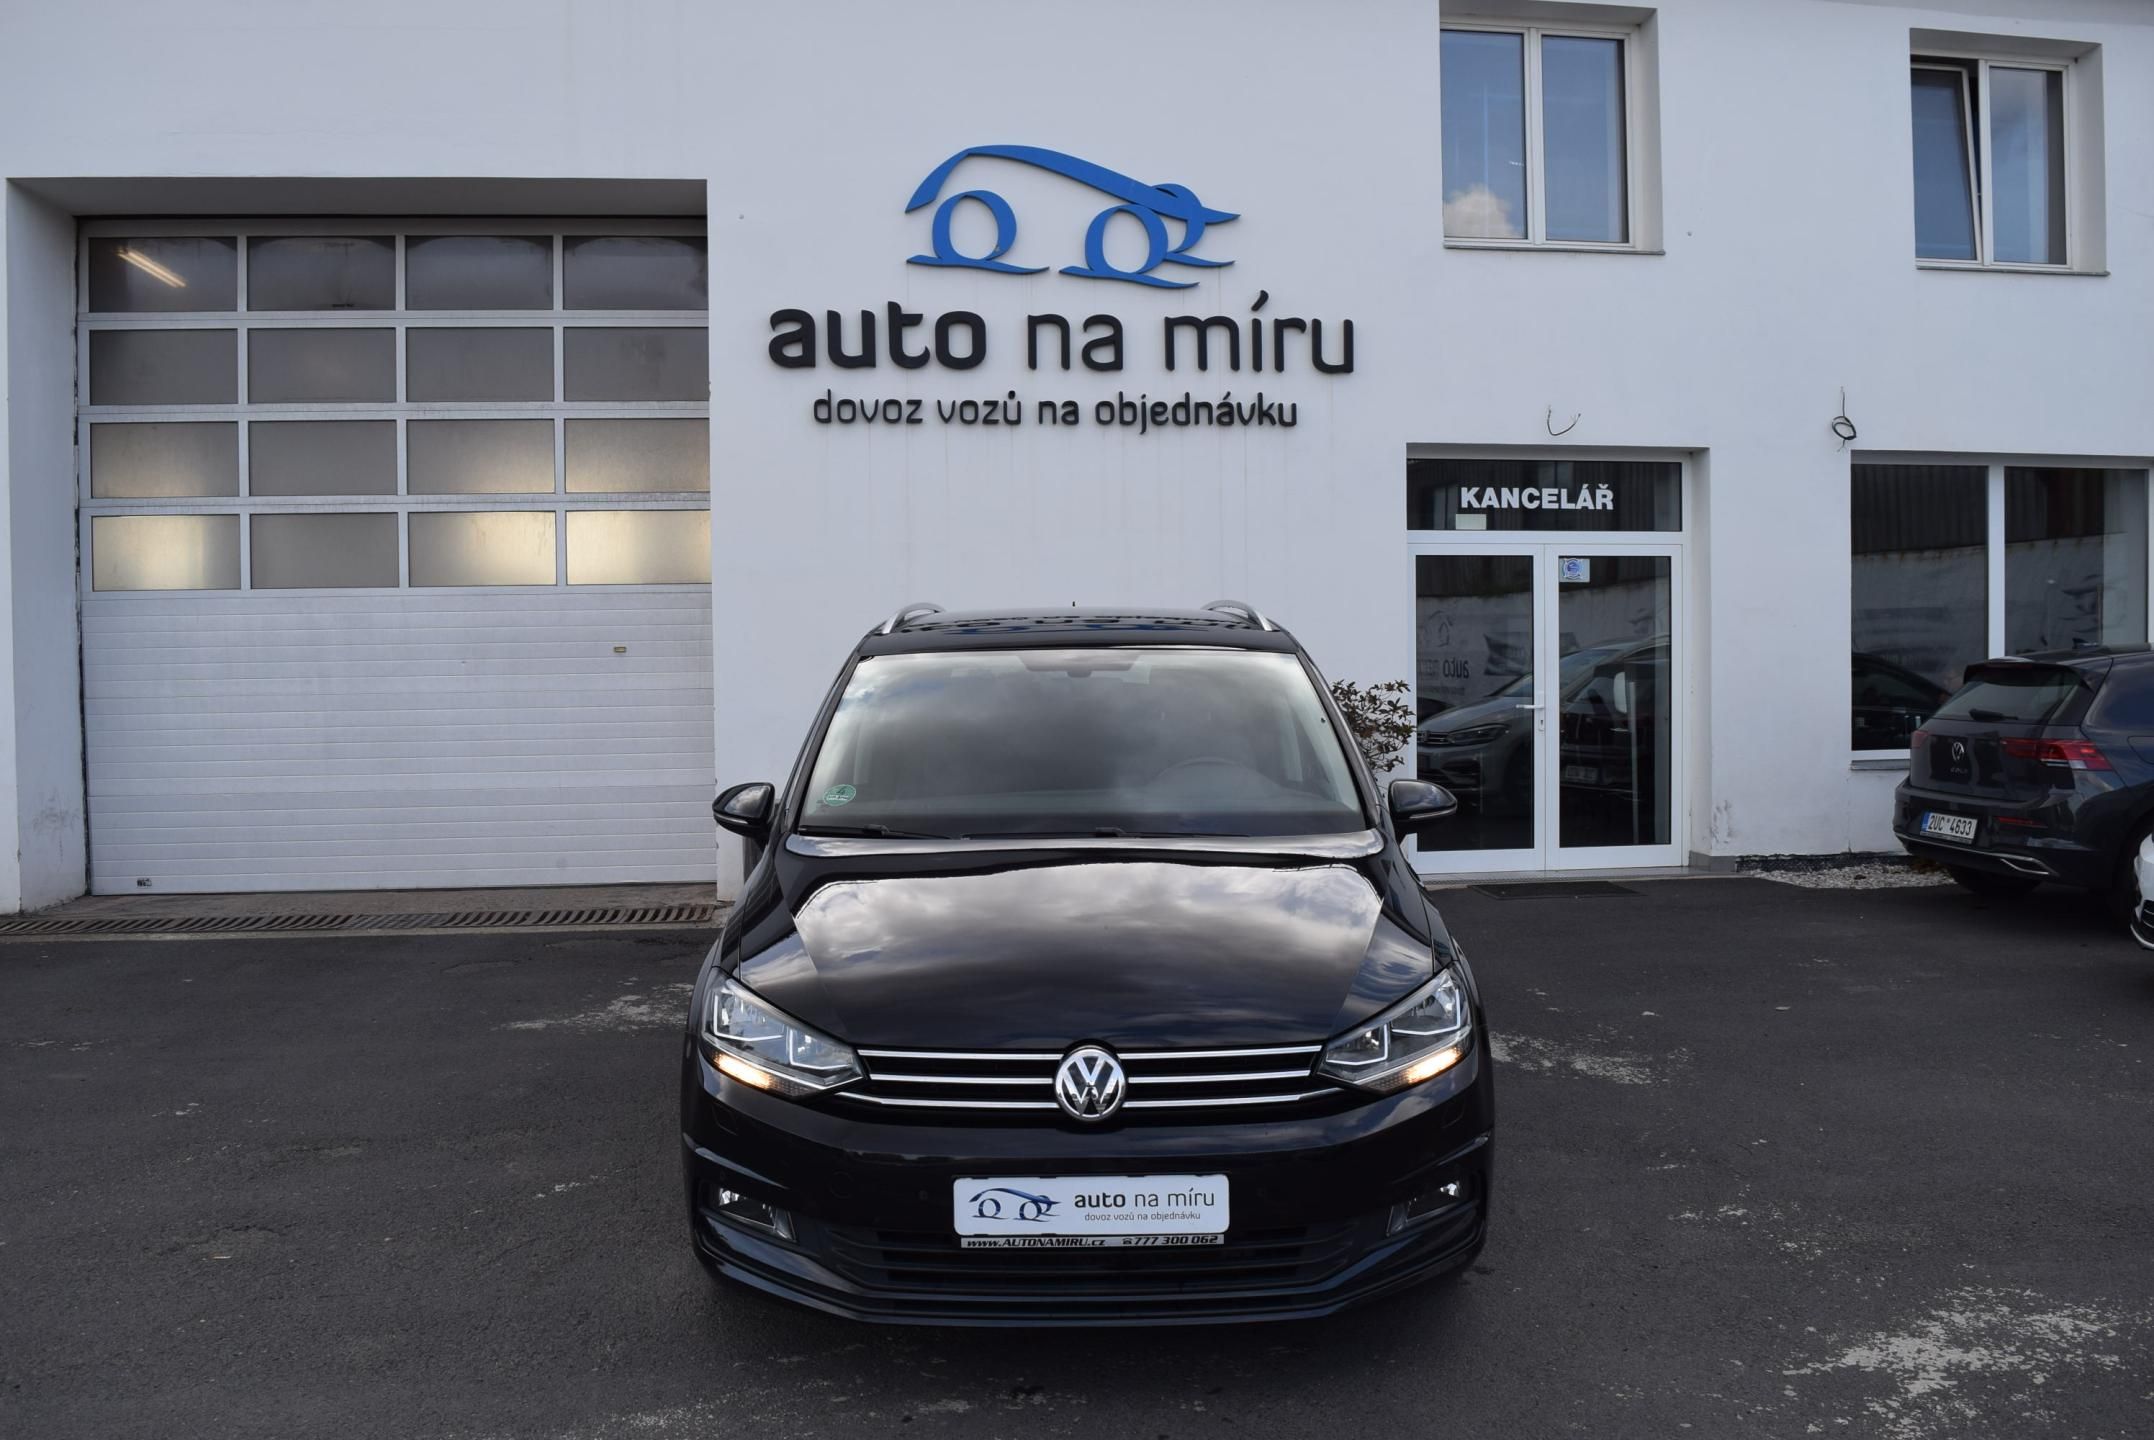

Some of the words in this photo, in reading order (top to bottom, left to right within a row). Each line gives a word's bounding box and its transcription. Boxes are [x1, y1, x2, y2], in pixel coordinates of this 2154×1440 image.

[768, 300, 987, 370] auto
[1027, 313, 1124, 373] na
[1164, 289, 1355, 375] míru
[813, 388, 924, 425] dovoz
[937, 390, 1022, 427] vozů
[1038, 400, 1080, 427] na
[1095, 390, 1298, 435] objednávku
[1461, 484, 1614, 511] KANCELÁŘ
[1928, 815, 1945, 831] 2UC
[1949, 817, 1973, 836] 4633
[1074, 1192, 1126, 1208] auto
[1134, 1193, 1159, 1207] na
[1167, 1187, 1215, 1206] míru
[1084, 1212, 1111, 1221] dovoz
[1150, 1211, 1201, 1222] objednávku
[1134, 1236, 1159, 1246] 777
[1161, 1235, 1190, 1245] 300
[1191, 1235, 1219, 1244] 062
